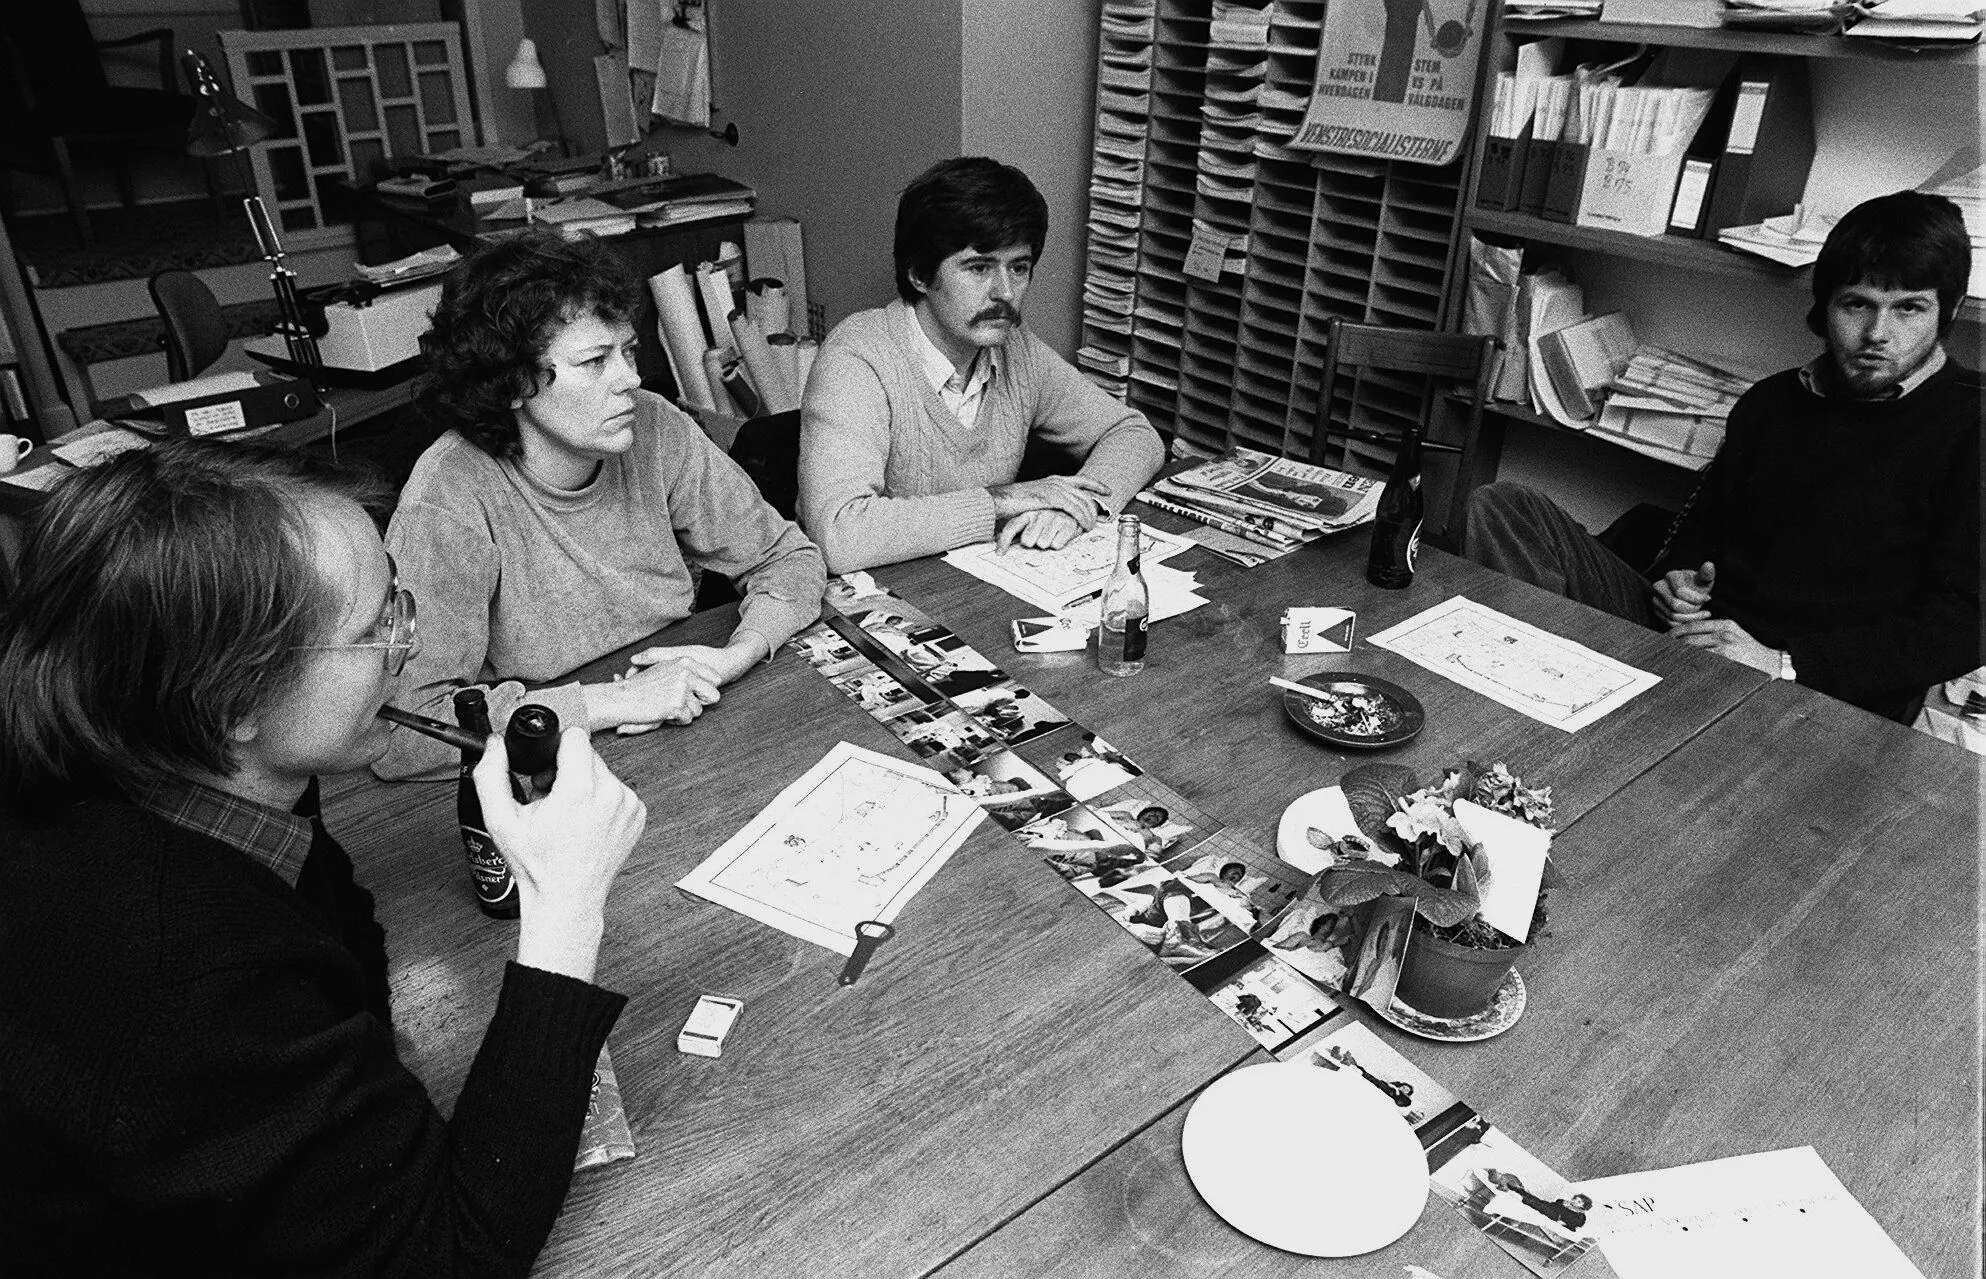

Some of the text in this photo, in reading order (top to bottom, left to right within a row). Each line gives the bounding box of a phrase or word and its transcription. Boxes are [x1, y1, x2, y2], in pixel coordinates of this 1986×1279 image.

[1348, 53, 1377, 66] STYRK
[1414, 59, 1441, 72] STEM
[1330, 68, 1374, 84] KAMPEN I
[1429, 75, 1443, 91] PÅ
[1318, 84, 1371, 99] HVERDAGEN
[1409, 93, 1465, 110] VALGDAGEN
[1301, 122, 1453, 161] VENSTRESOCIALISTERNE
[1297, 620, 1311, 649] Cecil
[1617, 1196, 1655, 1217] SAP
